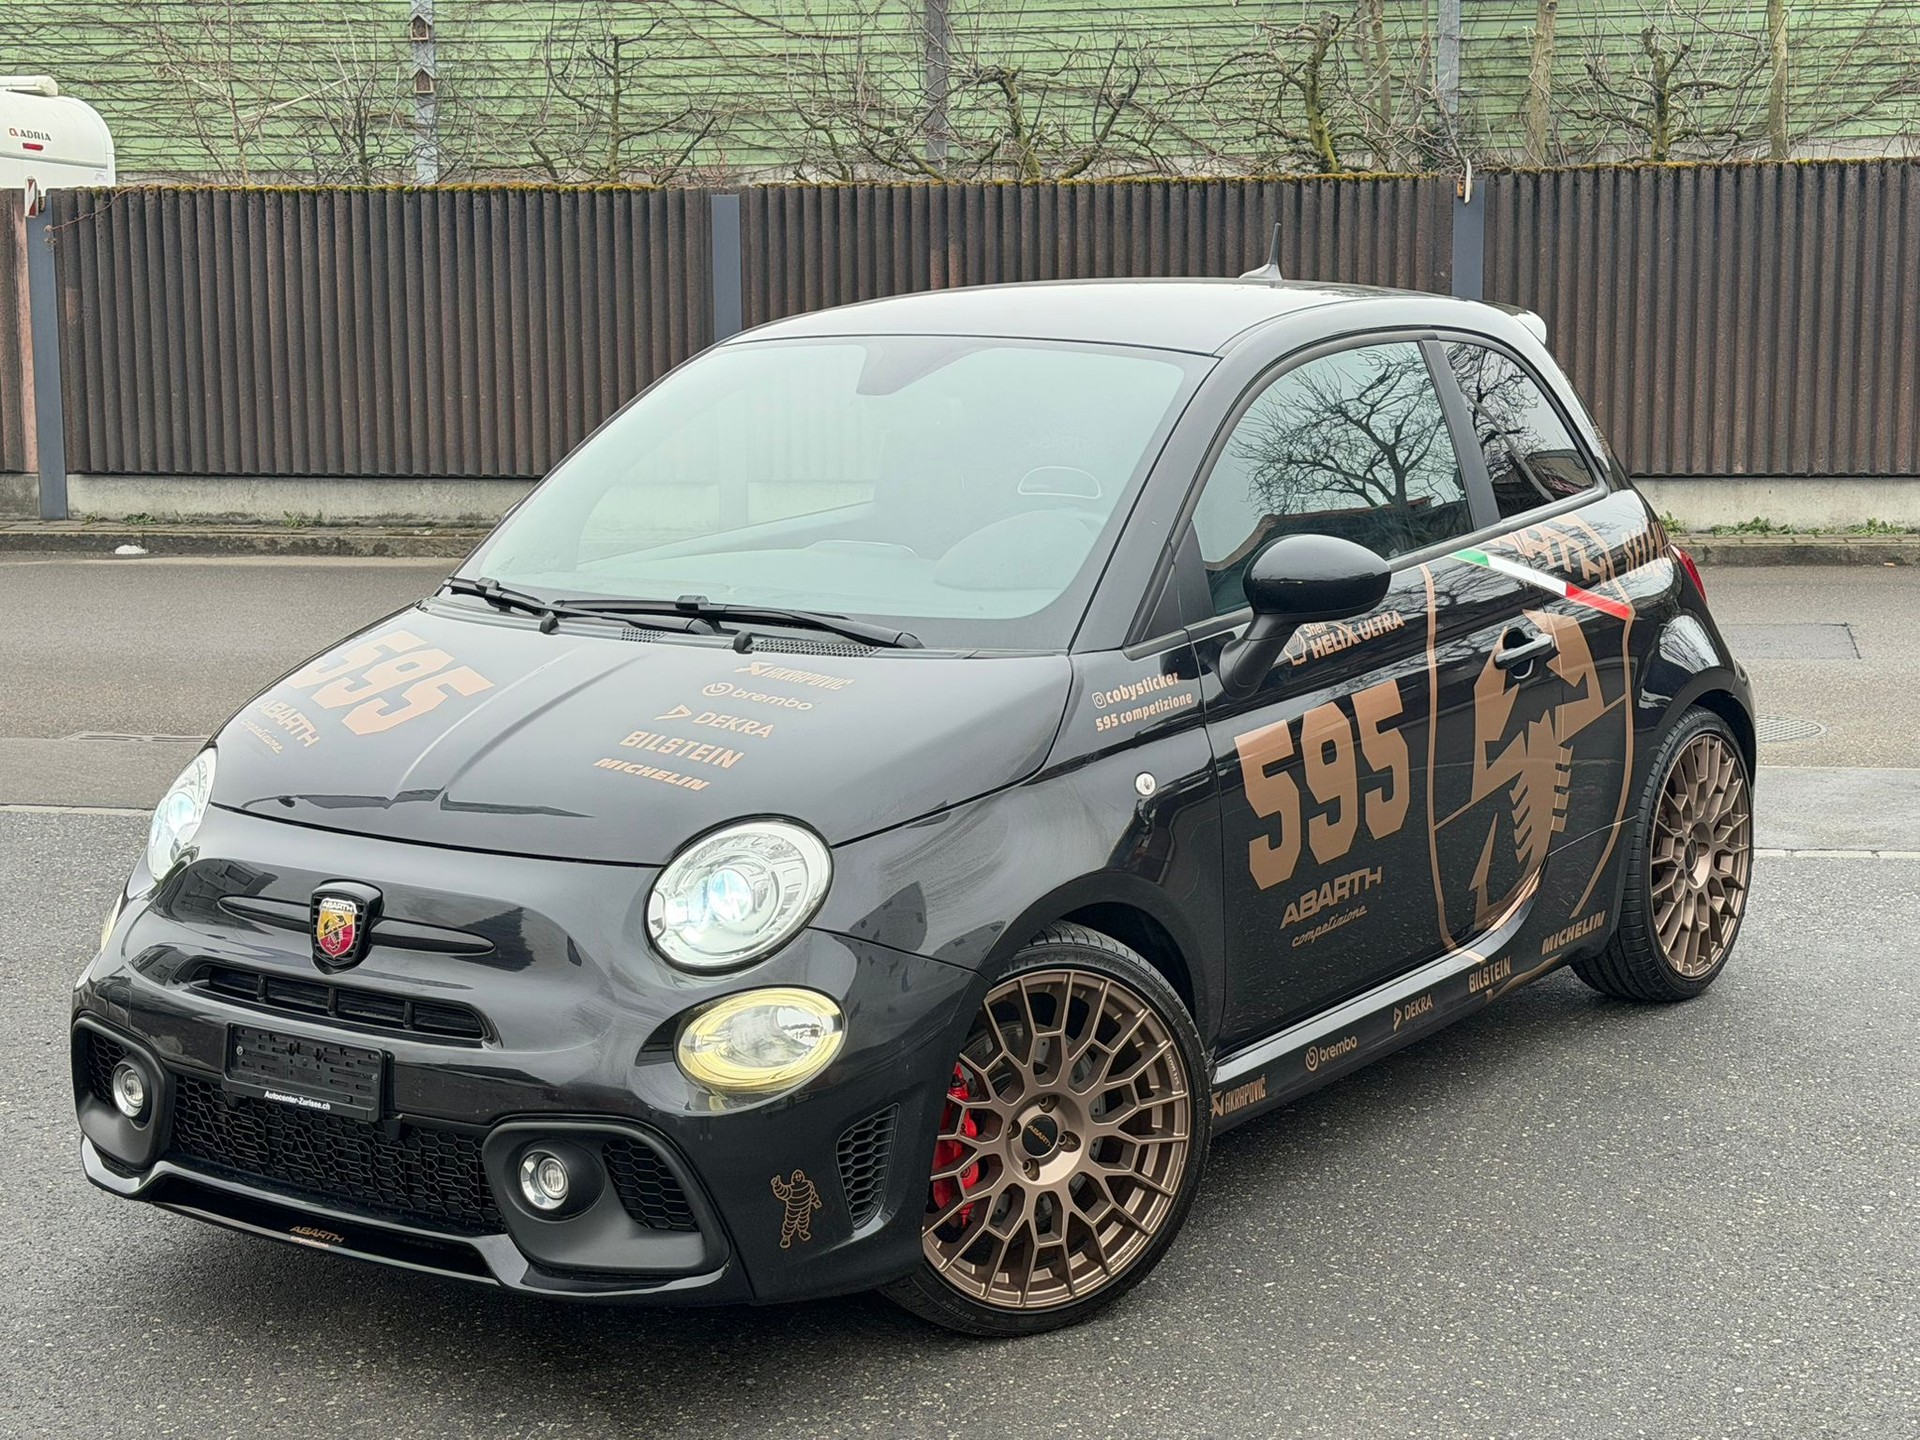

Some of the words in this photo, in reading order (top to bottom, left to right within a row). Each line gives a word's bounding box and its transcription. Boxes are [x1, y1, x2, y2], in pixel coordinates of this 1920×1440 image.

[20, 129, 52, 141] ADRIA
[1309, 625, 1361, 659] HELIX
[1358, 609, 1405, 640] ULTRA
[286, 629, 495, 736] 595
[731, 687, 813, 711] brembo
[256, 700, 320, 748] ABARTH
[692, 711, 776, 739] DEKRA
[1095, 713, 1119, 732] 595
[1120, 693, 1193, 723] competizione
[618, 730, 745, 769] BILSTEIN
[592, 757, 710, 791] MICHELIN
[1234, 679, 1410, 890] 595
[322, 900, 354, 912] ABARTH
[1280, 866, 1383, 930] ABARTH
[1291, 904, 1368, 948] competizione
[1541, 909, 1606, 956] MICHELIN
[1468, 956, 1512, 993] BILSTEIN
[1404, 993, 1434, 1021] DEKRA
[1320, 1036, 1358, 1062] brembo
[1028, 1125, 1054, 1149] ABARTH
[289, 1225, 345, 1243] ABARTH
